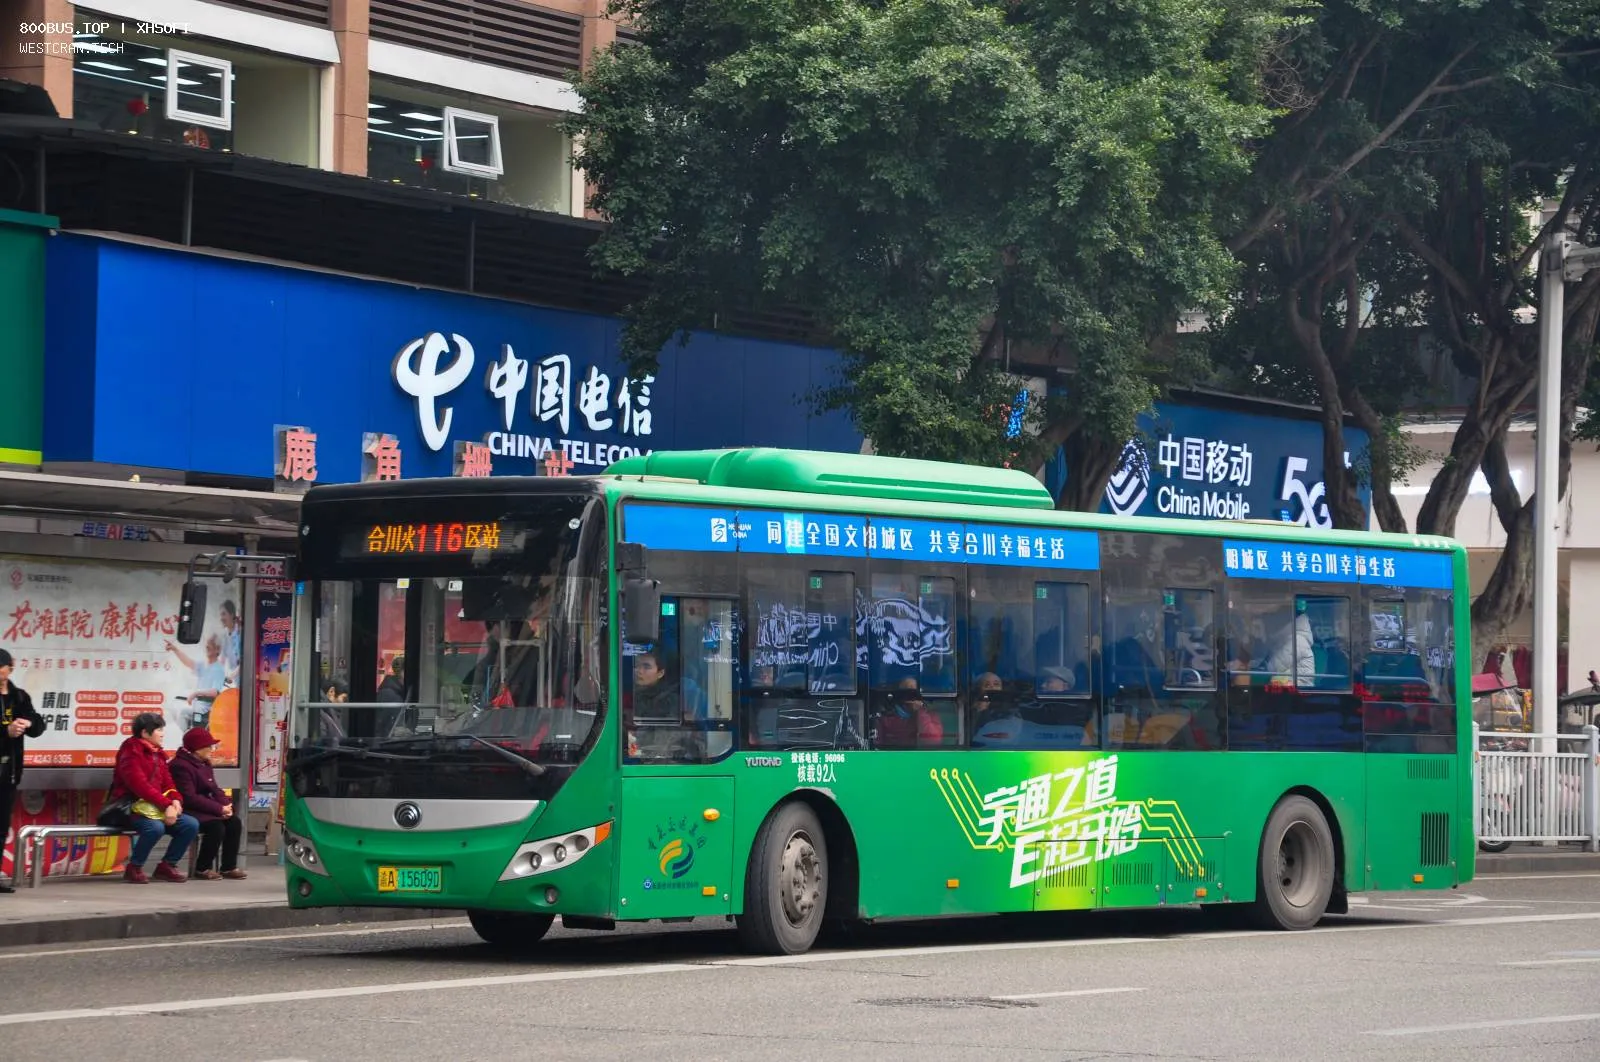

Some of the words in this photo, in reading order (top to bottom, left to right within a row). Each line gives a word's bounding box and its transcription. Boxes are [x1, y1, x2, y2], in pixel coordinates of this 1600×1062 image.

[488, 343, 655, 437] 中国电信
[487, 431, 554, 460] CHINA
[1158, 433, 1253, 487] 中国移动
[1157, 485, 1200, 515] China
[1203, 490, 1251, 520] Mobile
[1281, 456, 1333, 529] 5G
[929, 528, 1065, 560] 共享合川幸福生活
[1281, 551, 1396, 578] 共享合川幸福生活
[745, 756, 782, 767] YUTONG
[797, 763, 837, 782] 核载92人
[978, 754, 1119, 847] 宇通之道
